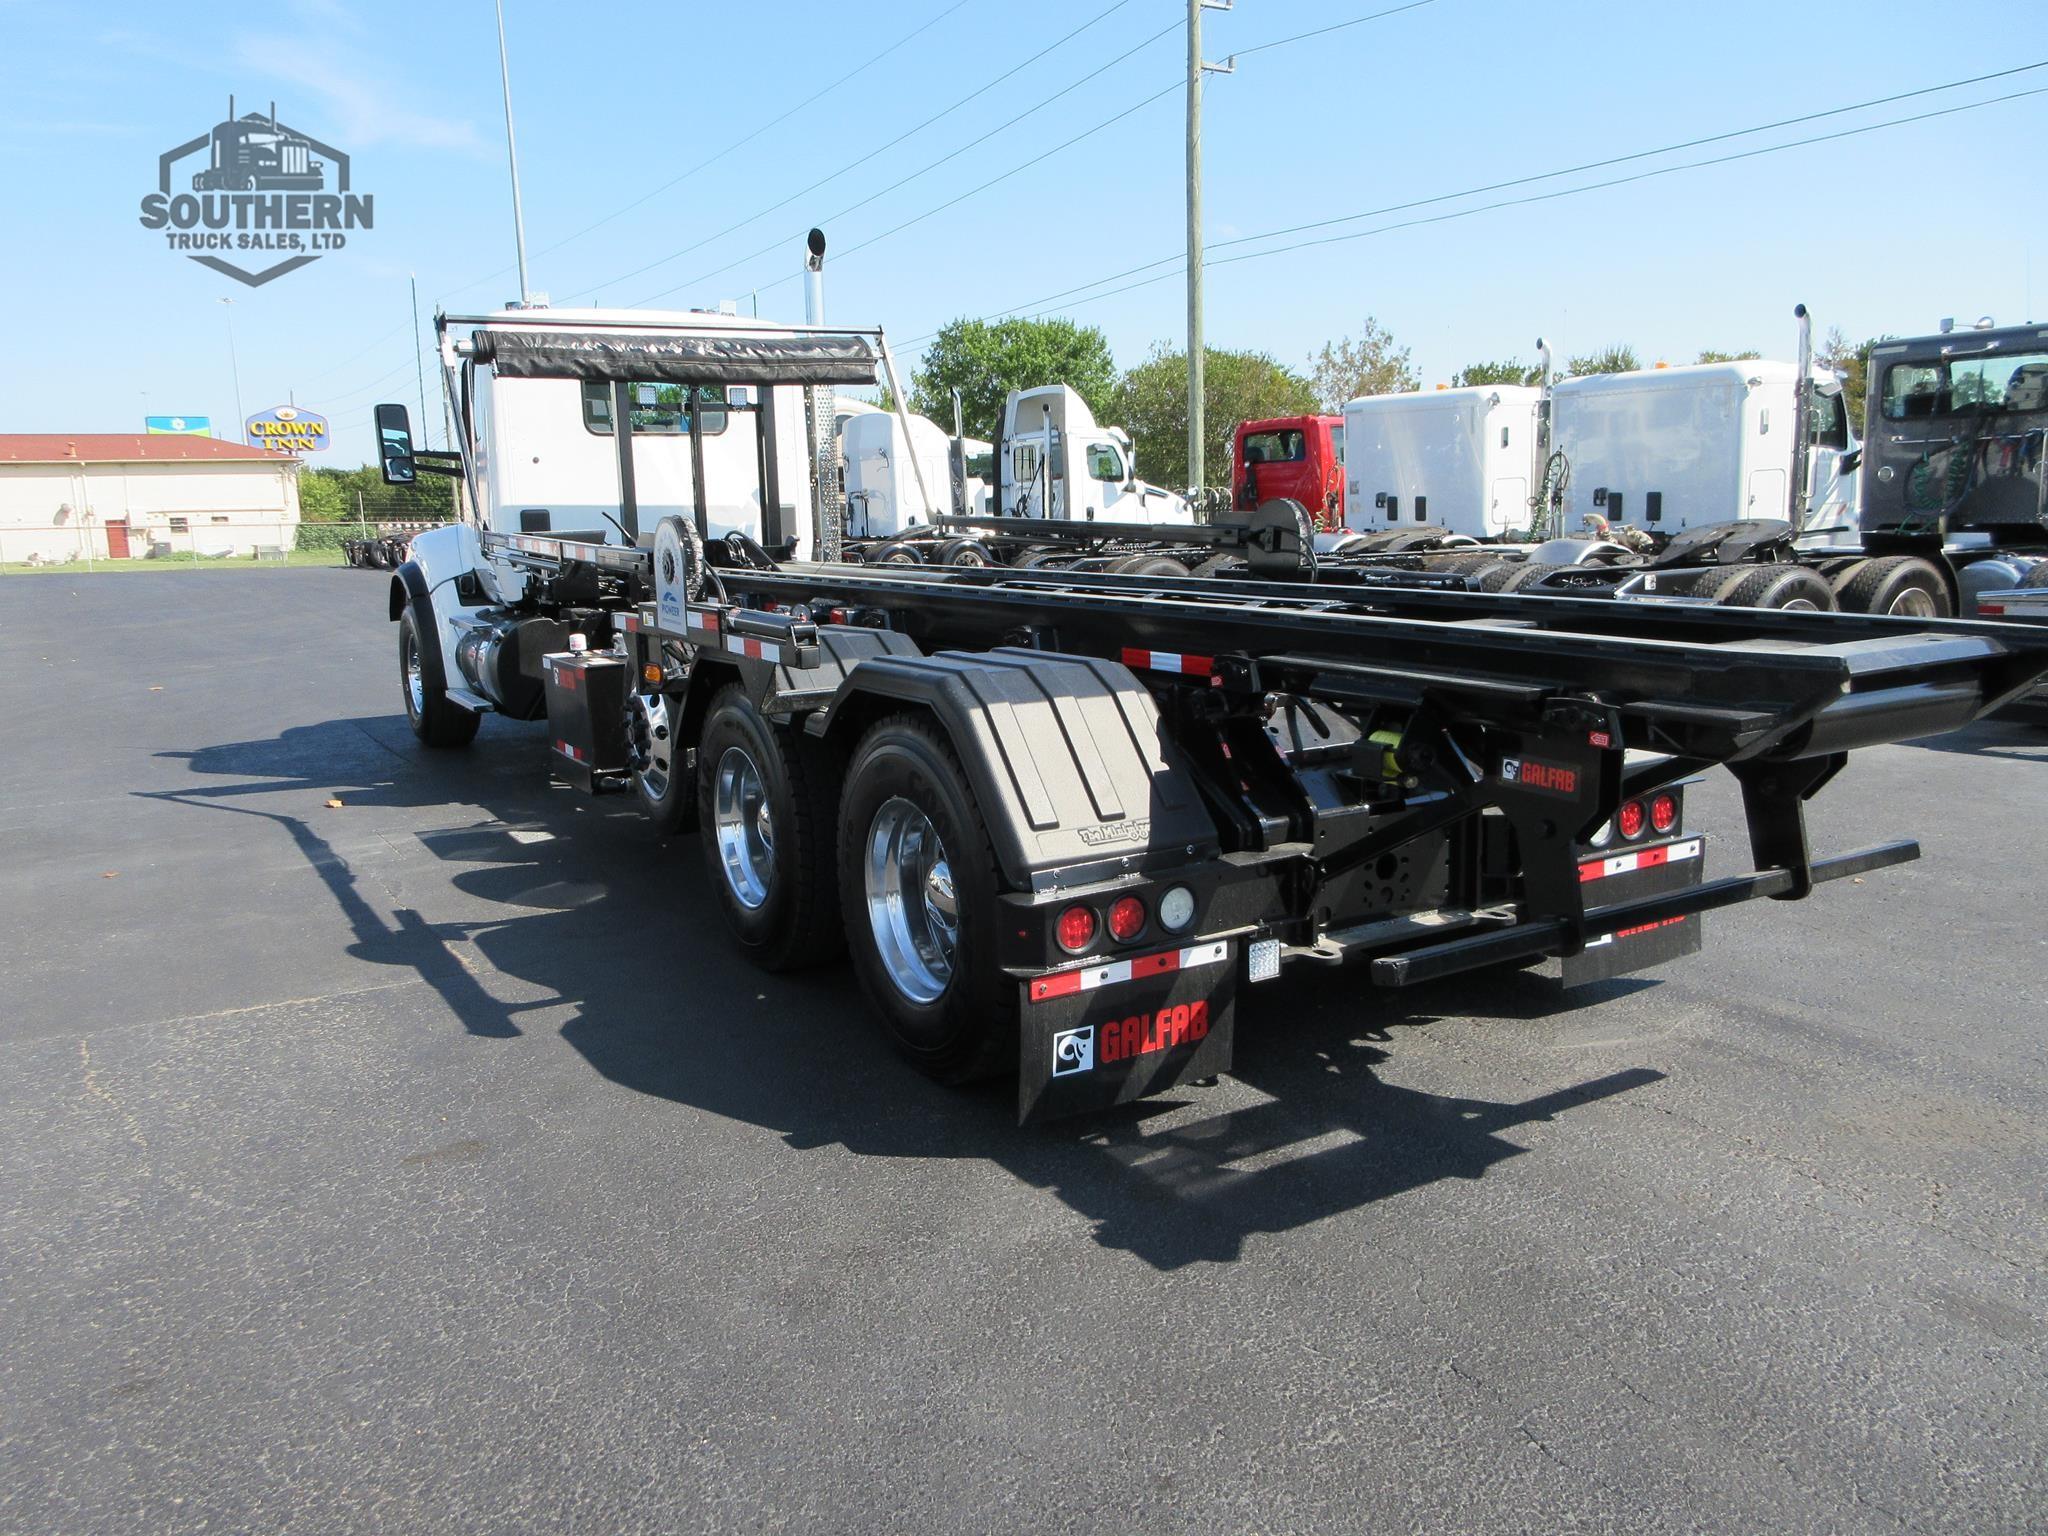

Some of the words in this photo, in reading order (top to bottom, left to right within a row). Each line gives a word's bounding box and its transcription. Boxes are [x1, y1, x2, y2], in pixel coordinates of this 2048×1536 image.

[250, 421, 325, 437] CROWN
[263, 437, 316, 450] INN
[1521, 761, 1577, 793] GALFAB
[1100, 999, 1209, 1064] GALFAB
